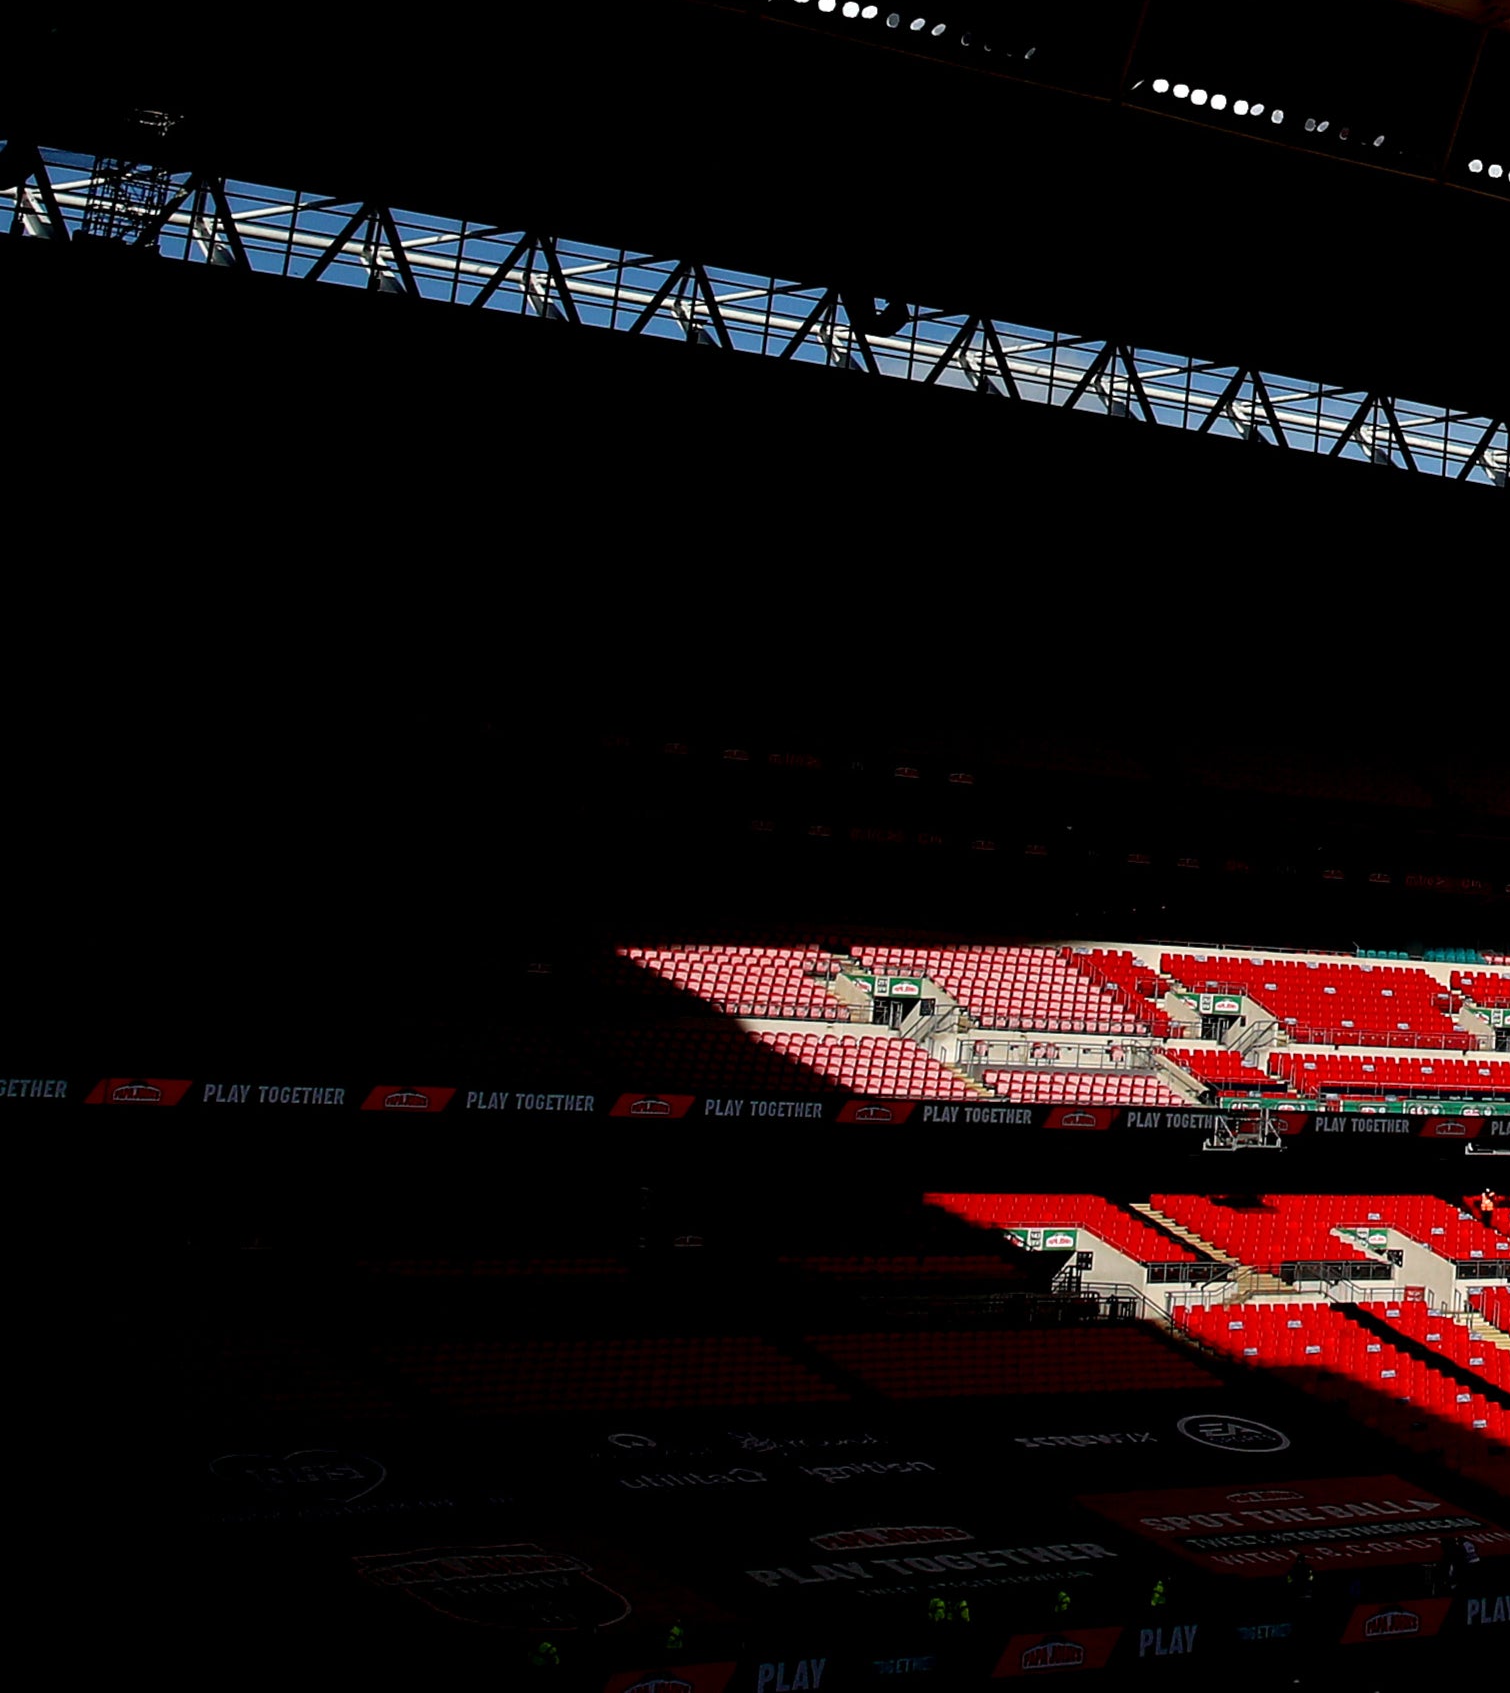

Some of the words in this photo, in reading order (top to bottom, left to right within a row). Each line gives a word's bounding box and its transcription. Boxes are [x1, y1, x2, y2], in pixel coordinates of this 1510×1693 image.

[203, 1083, 250, 1104] PLAY
[258, 1085, 345, 1106] TOGETHER
[466, 1091, 509, 1110] PLAY
[516, 1093, 595, 1112] TOGETHER
[705, 1099, 744, 1117] PLAY
[750, 1100, 823, 1119] TOGETHER
[923, 1106, 960, 1123] PLAY
[965, 1108, 1033, 1125] TOGETHER
[1127, 1112, 1161, 1128] PLAY
[1315, 1117, 1345, 1132] PLAY
[1352, 1118, 1410, 1133] TOGETHER
[1140, 1512, 1244, 1532] SPOT
[1240, 1504, 1326, 1524] THE
[1317, 1500, 1422, 1518] BALL
[745, 1561, 874, 1588] PLAY
[870, 1542, 1119, 1576] TOGETHER
[1211, 1551, 1290, 1566] WITH
[1137, 1624, 1199, 1657] PLAY
[757, 1658, 828, 1693] PLAY
